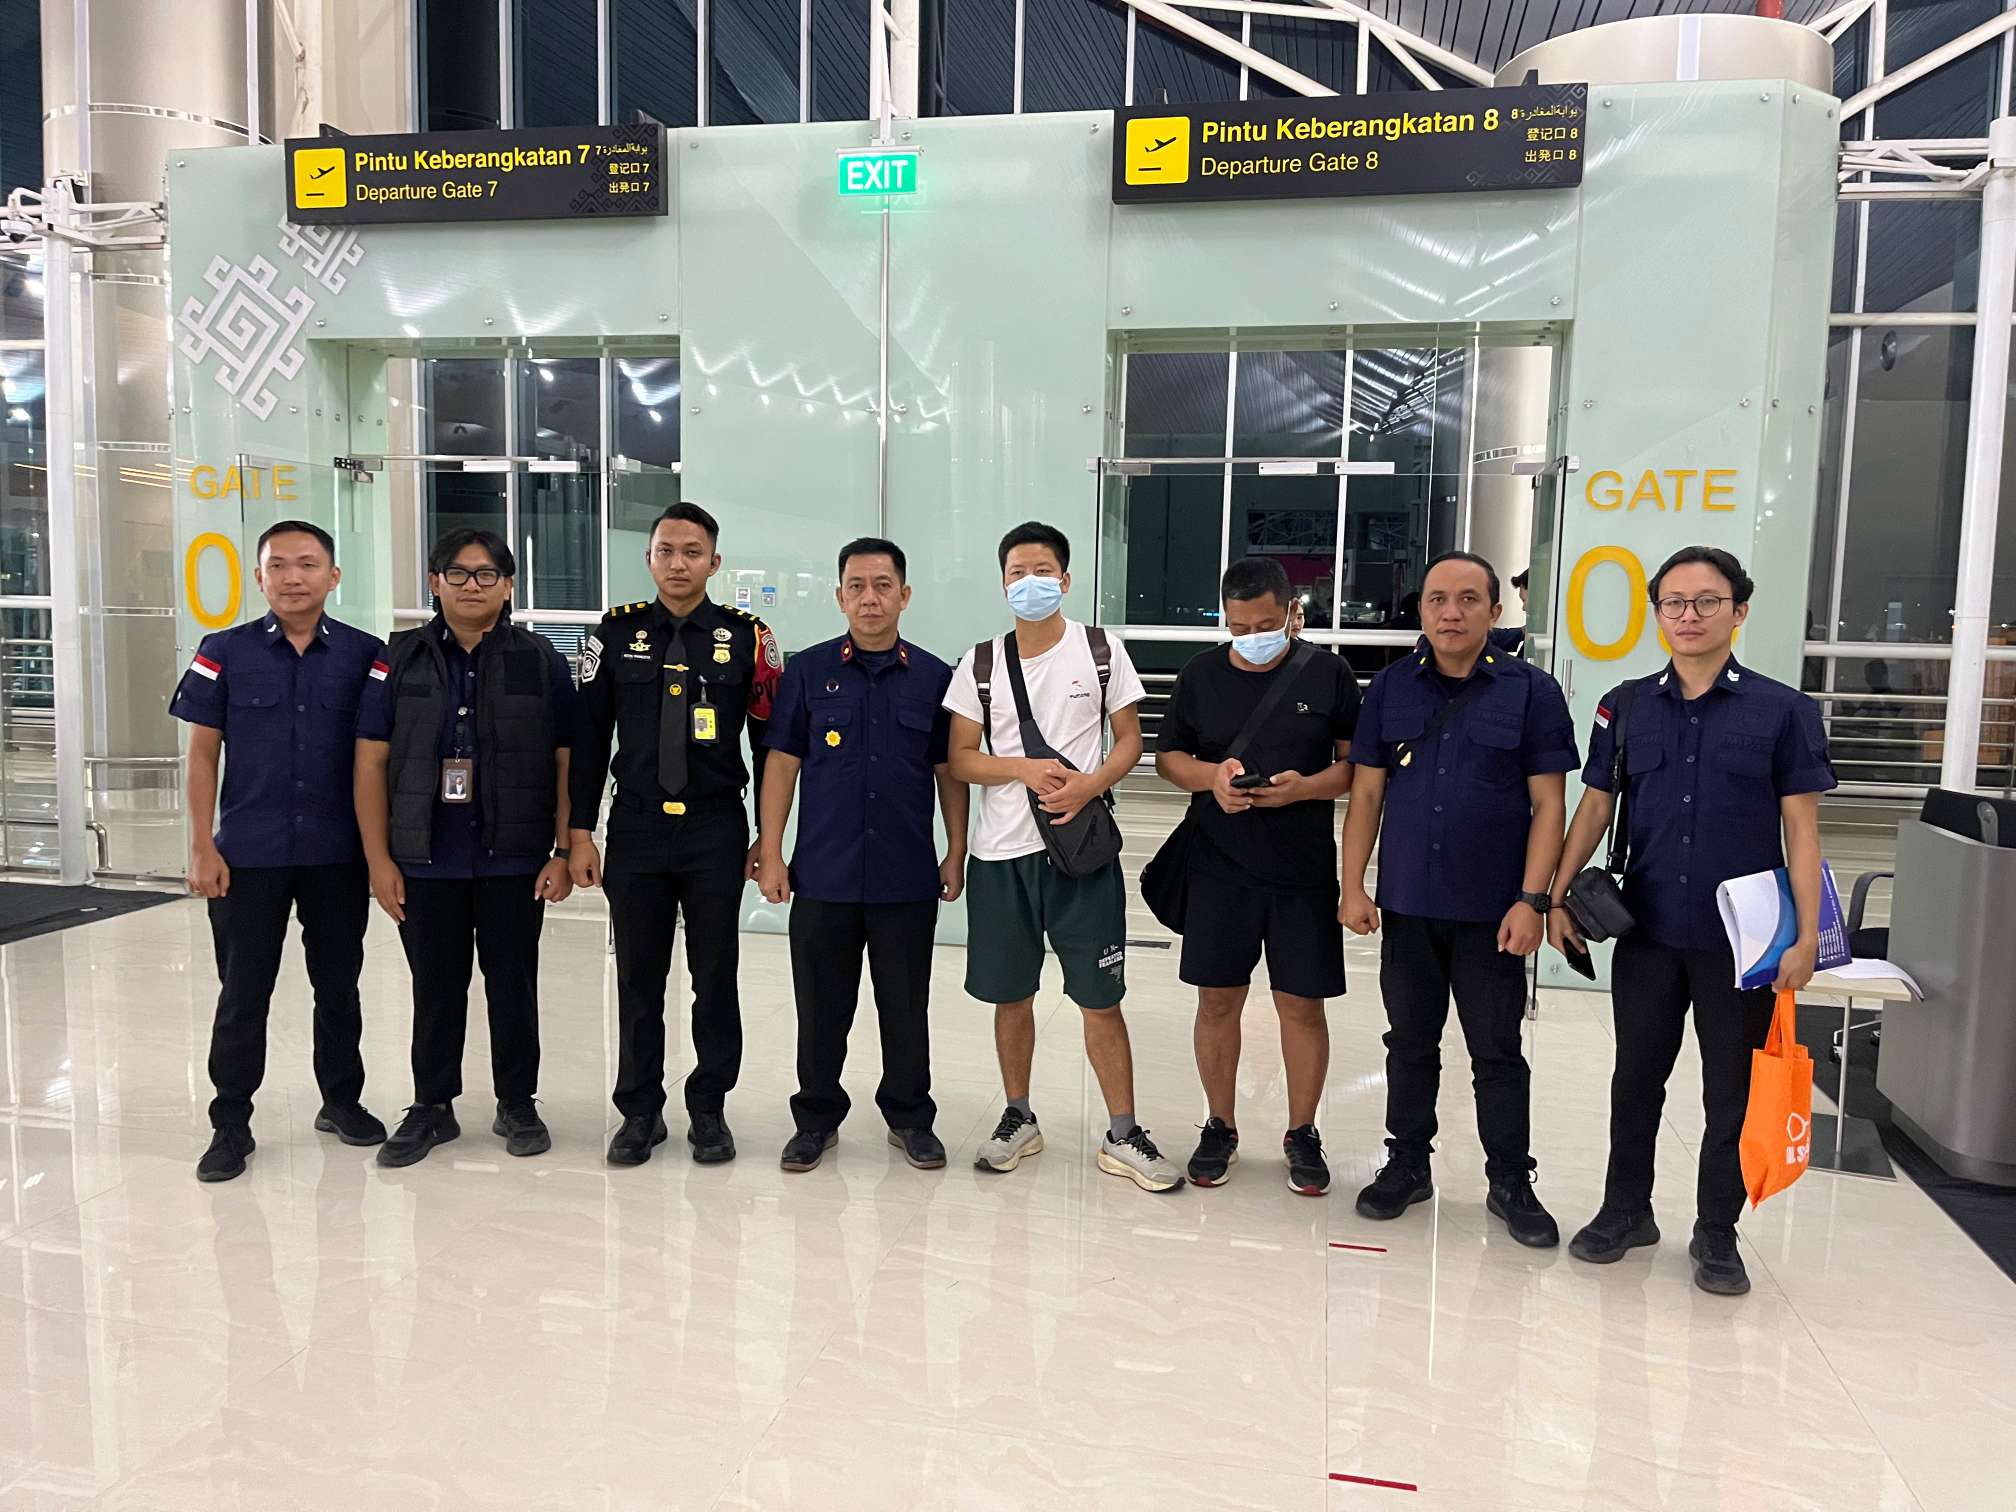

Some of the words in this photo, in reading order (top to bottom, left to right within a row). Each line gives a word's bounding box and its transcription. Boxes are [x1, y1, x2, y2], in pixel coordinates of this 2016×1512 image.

[1202, 121, 1267, 143] Pintu
[1276, 112, 1475, 141] Keberangkatan
[1483, 108, 1499, 131] 8
[1570, 127, 1578, 139] 8
[355, 152, 408, 172] Pintu
[414, 147, 572, 172] Keberangkatan
[577, 144, 591, 164] 7
[1201, 156, 1302, 180] Departure
[1309, 152, 1360, 172] Gate
[1365, 151, 1379, 170] 8
[1568, 149, 1577, 160] 8
[642, 163, 650, 173] 7
[847, 160, 909, 190] EXIT
[356, 184, 437, 204] Departure
[442, 181, 483, 200] Gate
[487, 181, 498, 197] 7
[642, 182, 650, 192] 7
[1585, 469, 1738, 512] GATE
